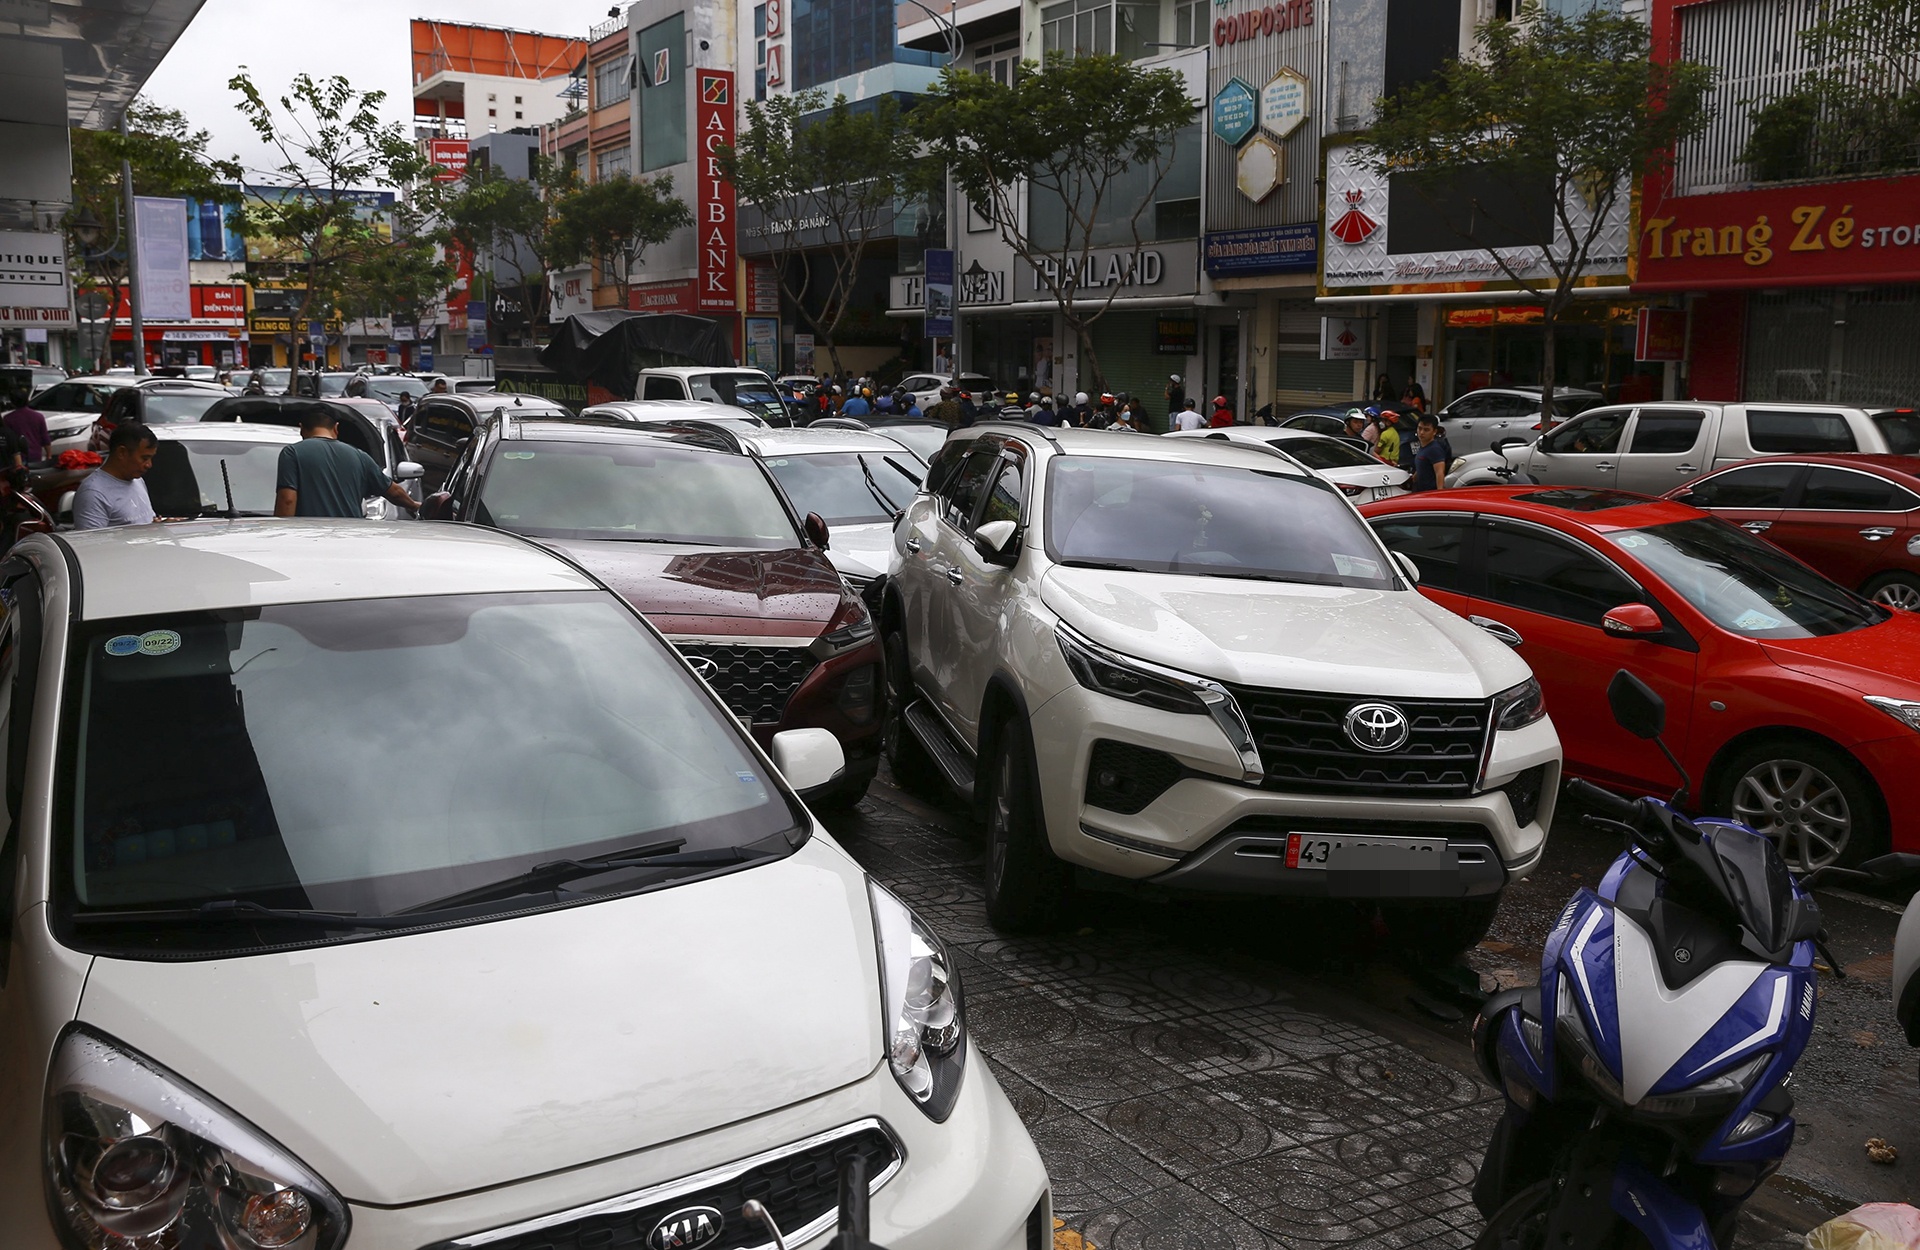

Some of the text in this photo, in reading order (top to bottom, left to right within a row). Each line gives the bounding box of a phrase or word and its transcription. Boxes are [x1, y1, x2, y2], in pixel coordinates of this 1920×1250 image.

[1214, 0, 1313, 47] COMPOSITE
[706, 111, 727, 291] AGRIBANK
[1223, 241, 1243, 257] HÀNG
[1259, 236, 1279, 254] CHẤT
[1280, 238, 1296, 252] KIM
[1644, 215, 1773, 266] Trang
[1789, 205, 1855, 252] Zé
[1032, 250, 1162, 291] THAILAND
[215, 291, 232, 300] BÁN
[645, 293, 678, 307] AGRIBANK
[145, 638, 174, 647] 09/22
[1800, 981, 1815, 1021] YAMAHA
[659, 1213, 717, 1250] KIA
